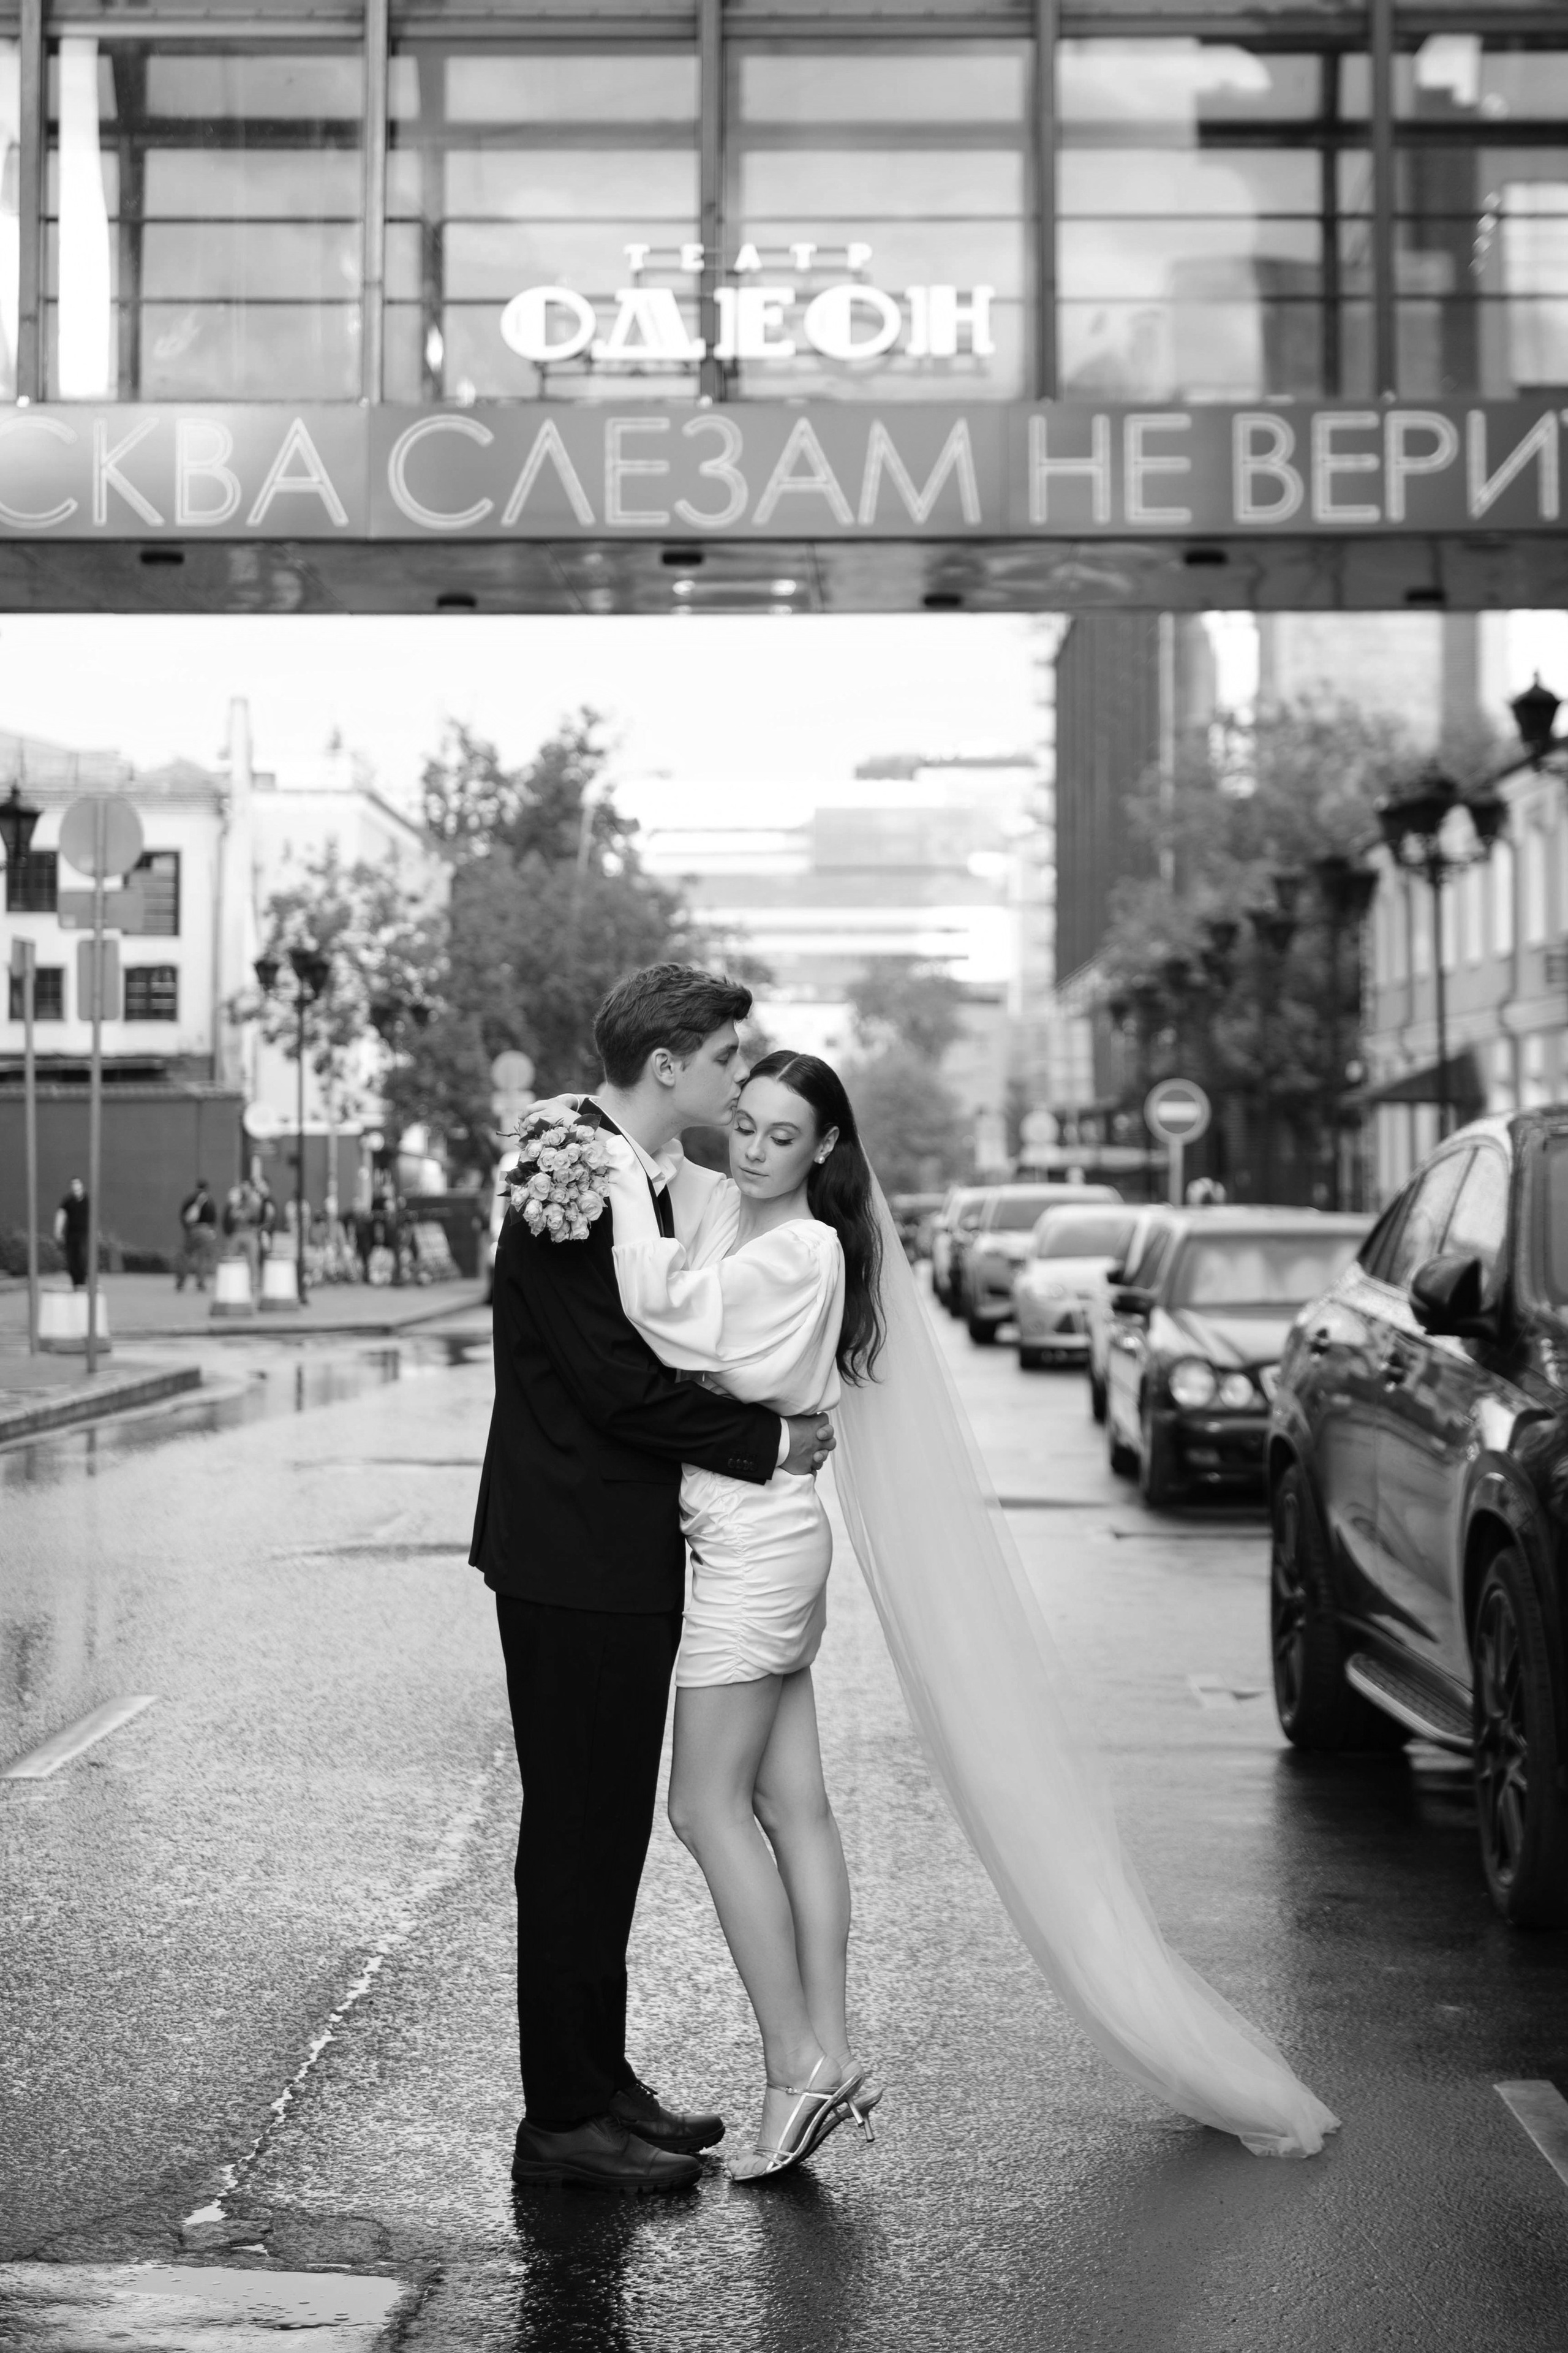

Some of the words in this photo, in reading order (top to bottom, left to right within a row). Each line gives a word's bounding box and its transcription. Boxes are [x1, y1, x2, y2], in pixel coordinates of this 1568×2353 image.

[624, 243, 873, 271] ТЕАТР
[500, 284, 996, 361] ОДЕОН
[388, 414, 983, 531] СЛЕЗАМ
[1028, 413, 1192, 525] НЕ
[1232, 409, 1568, 524] ВЕРИ
